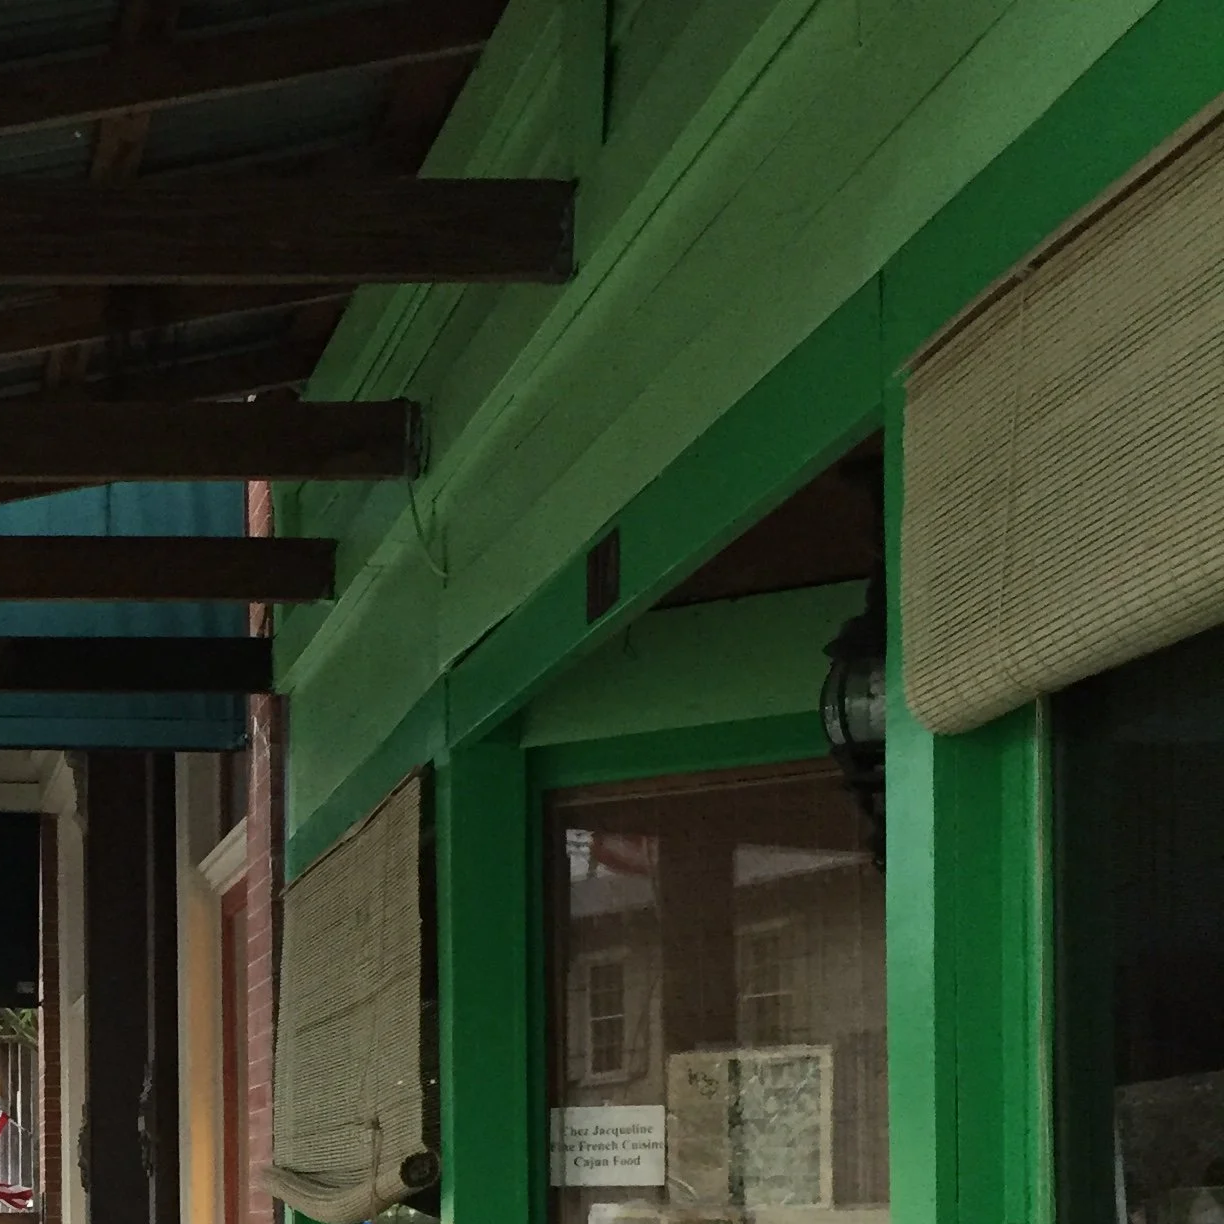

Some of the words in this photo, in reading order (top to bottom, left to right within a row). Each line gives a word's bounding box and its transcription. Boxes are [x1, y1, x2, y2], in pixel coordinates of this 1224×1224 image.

[592, 1123, 654, 1138] Jacqueline
[579, 1140, 618, 1152] French
[574, 1155, 609, 1170] Cajun
[613, 1154, 641, 1167] Food
